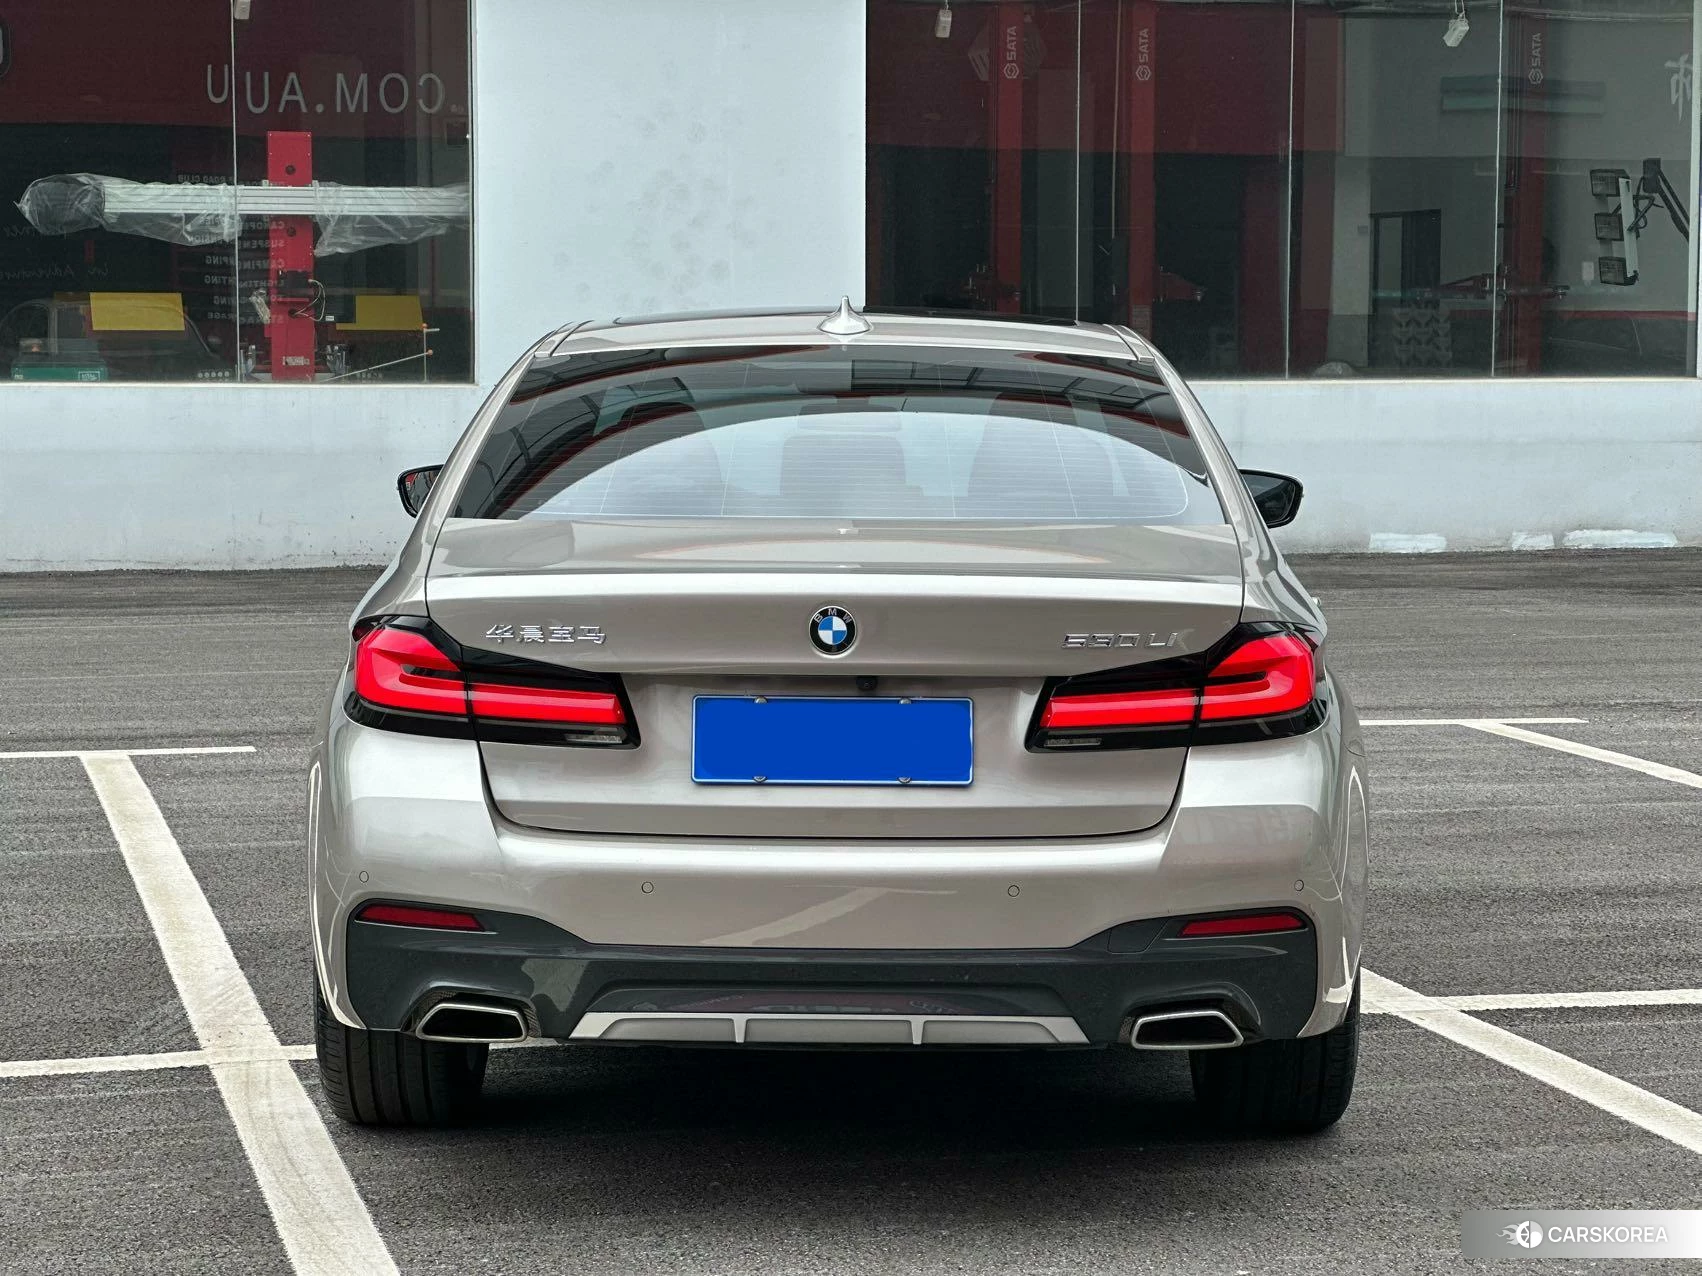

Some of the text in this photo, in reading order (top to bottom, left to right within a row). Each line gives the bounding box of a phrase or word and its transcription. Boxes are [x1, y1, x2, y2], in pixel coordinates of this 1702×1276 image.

[1006, 25, 1017, 61] SATA
[1138, 28, 1150, 63] SATA
[1531, 32, 1542, 67] SATA
[813, 608, 852, 624] BMW
[485, 624, 606, 644] 华晨宝马
[1061, 632, 1141, 648] 530
